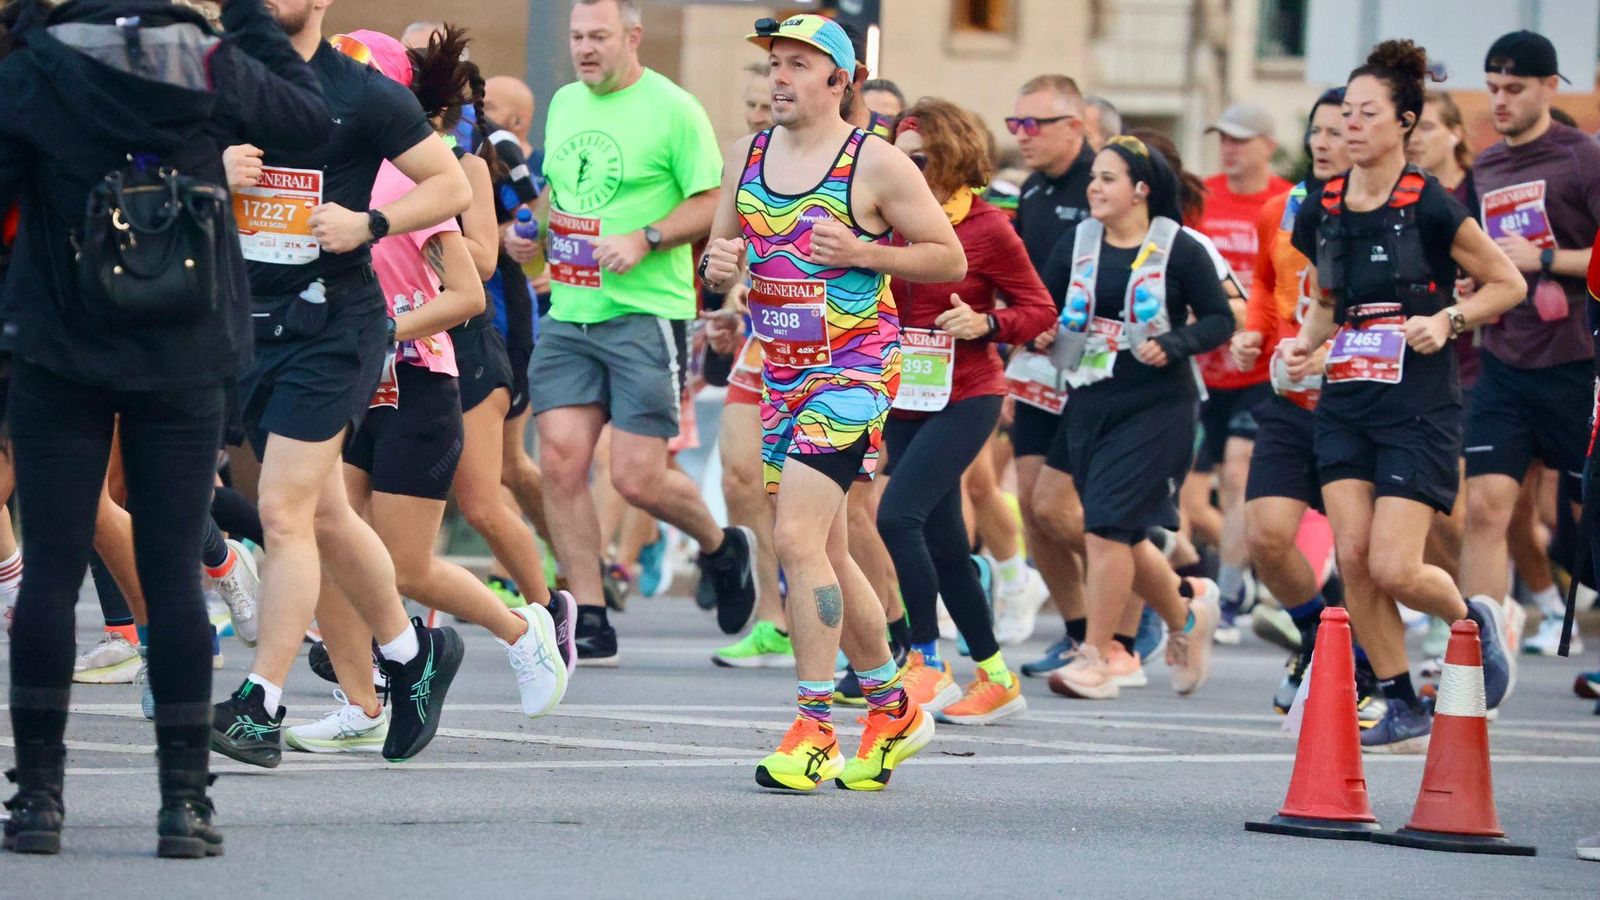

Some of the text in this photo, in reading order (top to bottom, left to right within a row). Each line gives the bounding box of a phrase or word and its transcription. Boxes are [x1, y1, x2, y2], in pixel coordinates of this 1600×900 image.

[256, 172, 313, 189] ENERALI
[242, 200, 297, 221] 17227
[553, 236, 579, 255] 2661
[760, 282, 818, 297] GENERALI
[761, 309, 800, 328] 2308
[901, 333, 946, 347] ENERALI
[1345, 332, 1383, 347] 7465
